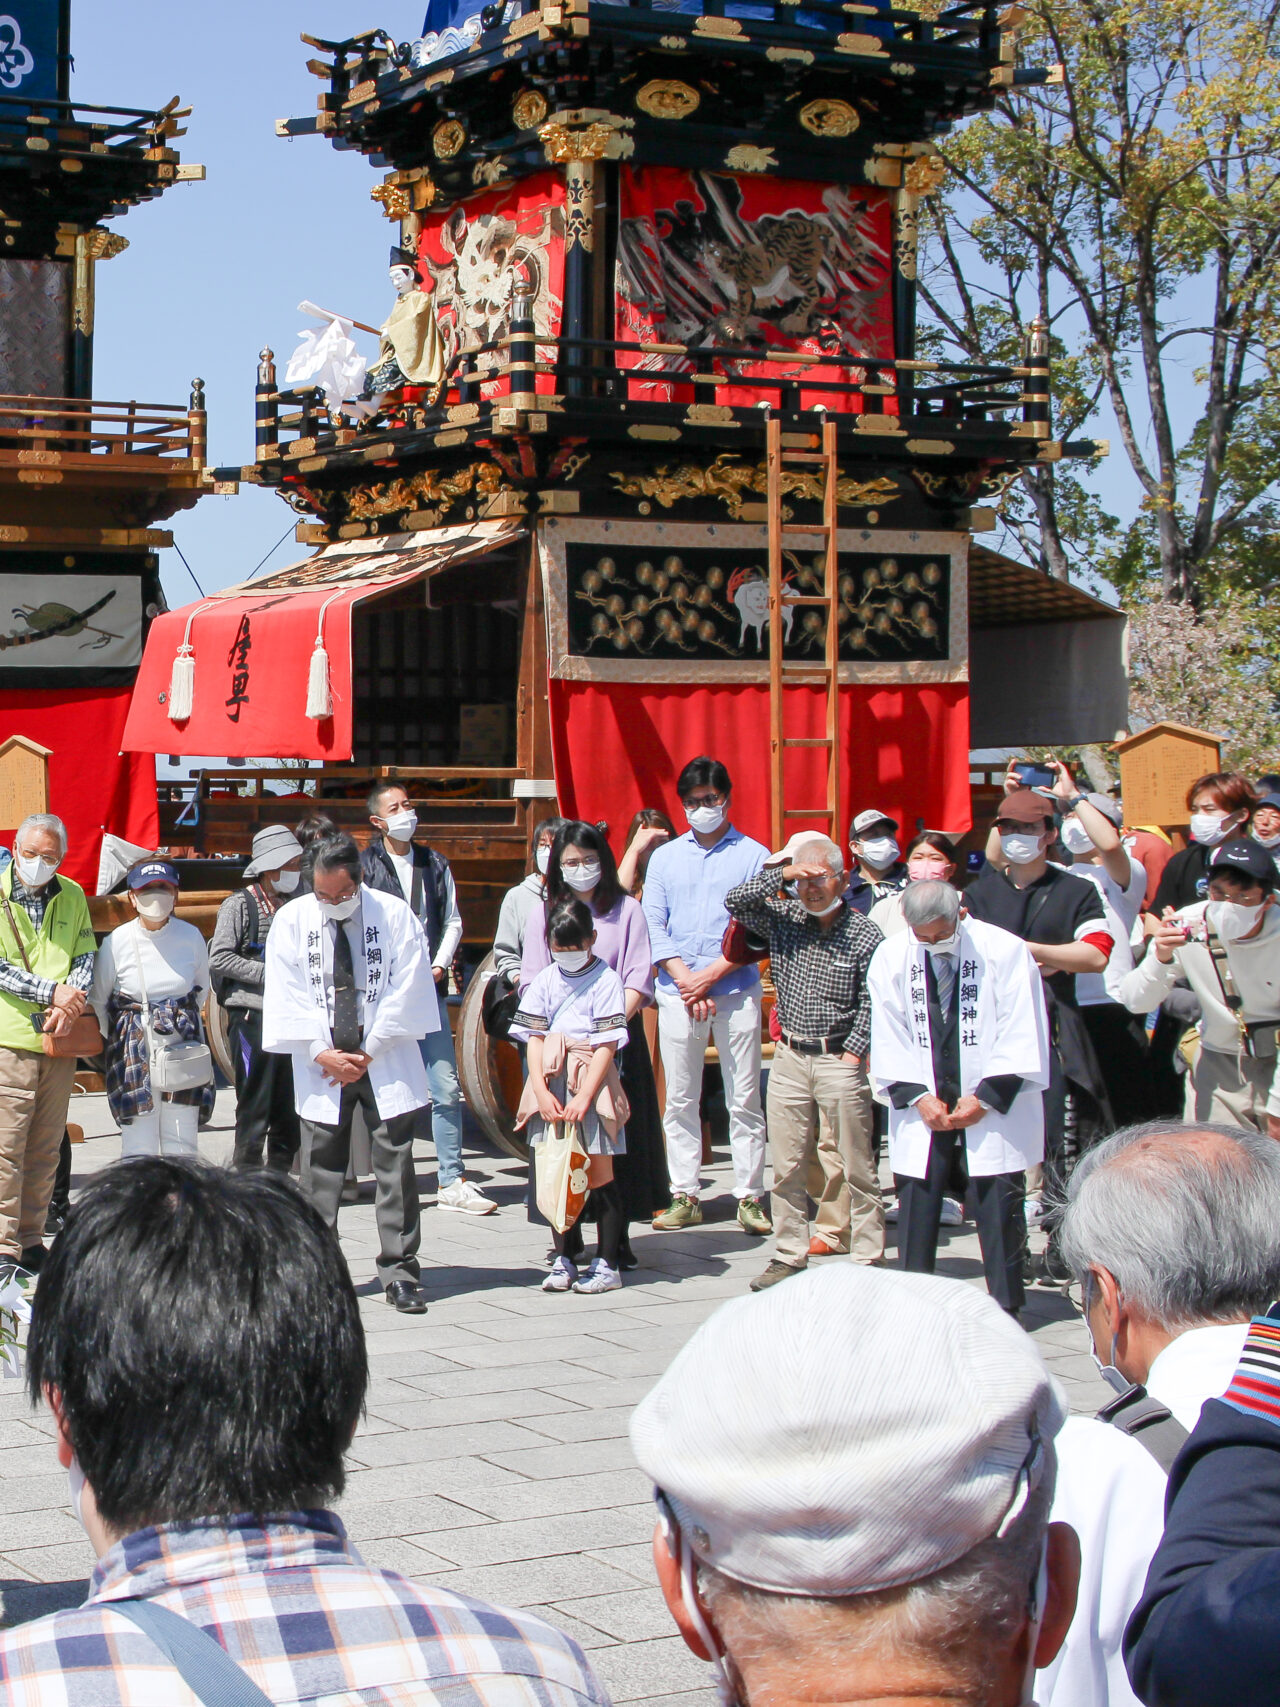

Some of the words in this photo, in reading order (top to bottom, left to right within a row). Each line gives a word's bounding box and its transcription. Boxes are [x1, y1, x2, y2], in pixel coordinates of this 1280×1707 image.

[365, 926, 382, 1004] 針綱神社
[960, 960, 978, 1047] 針綱神社
